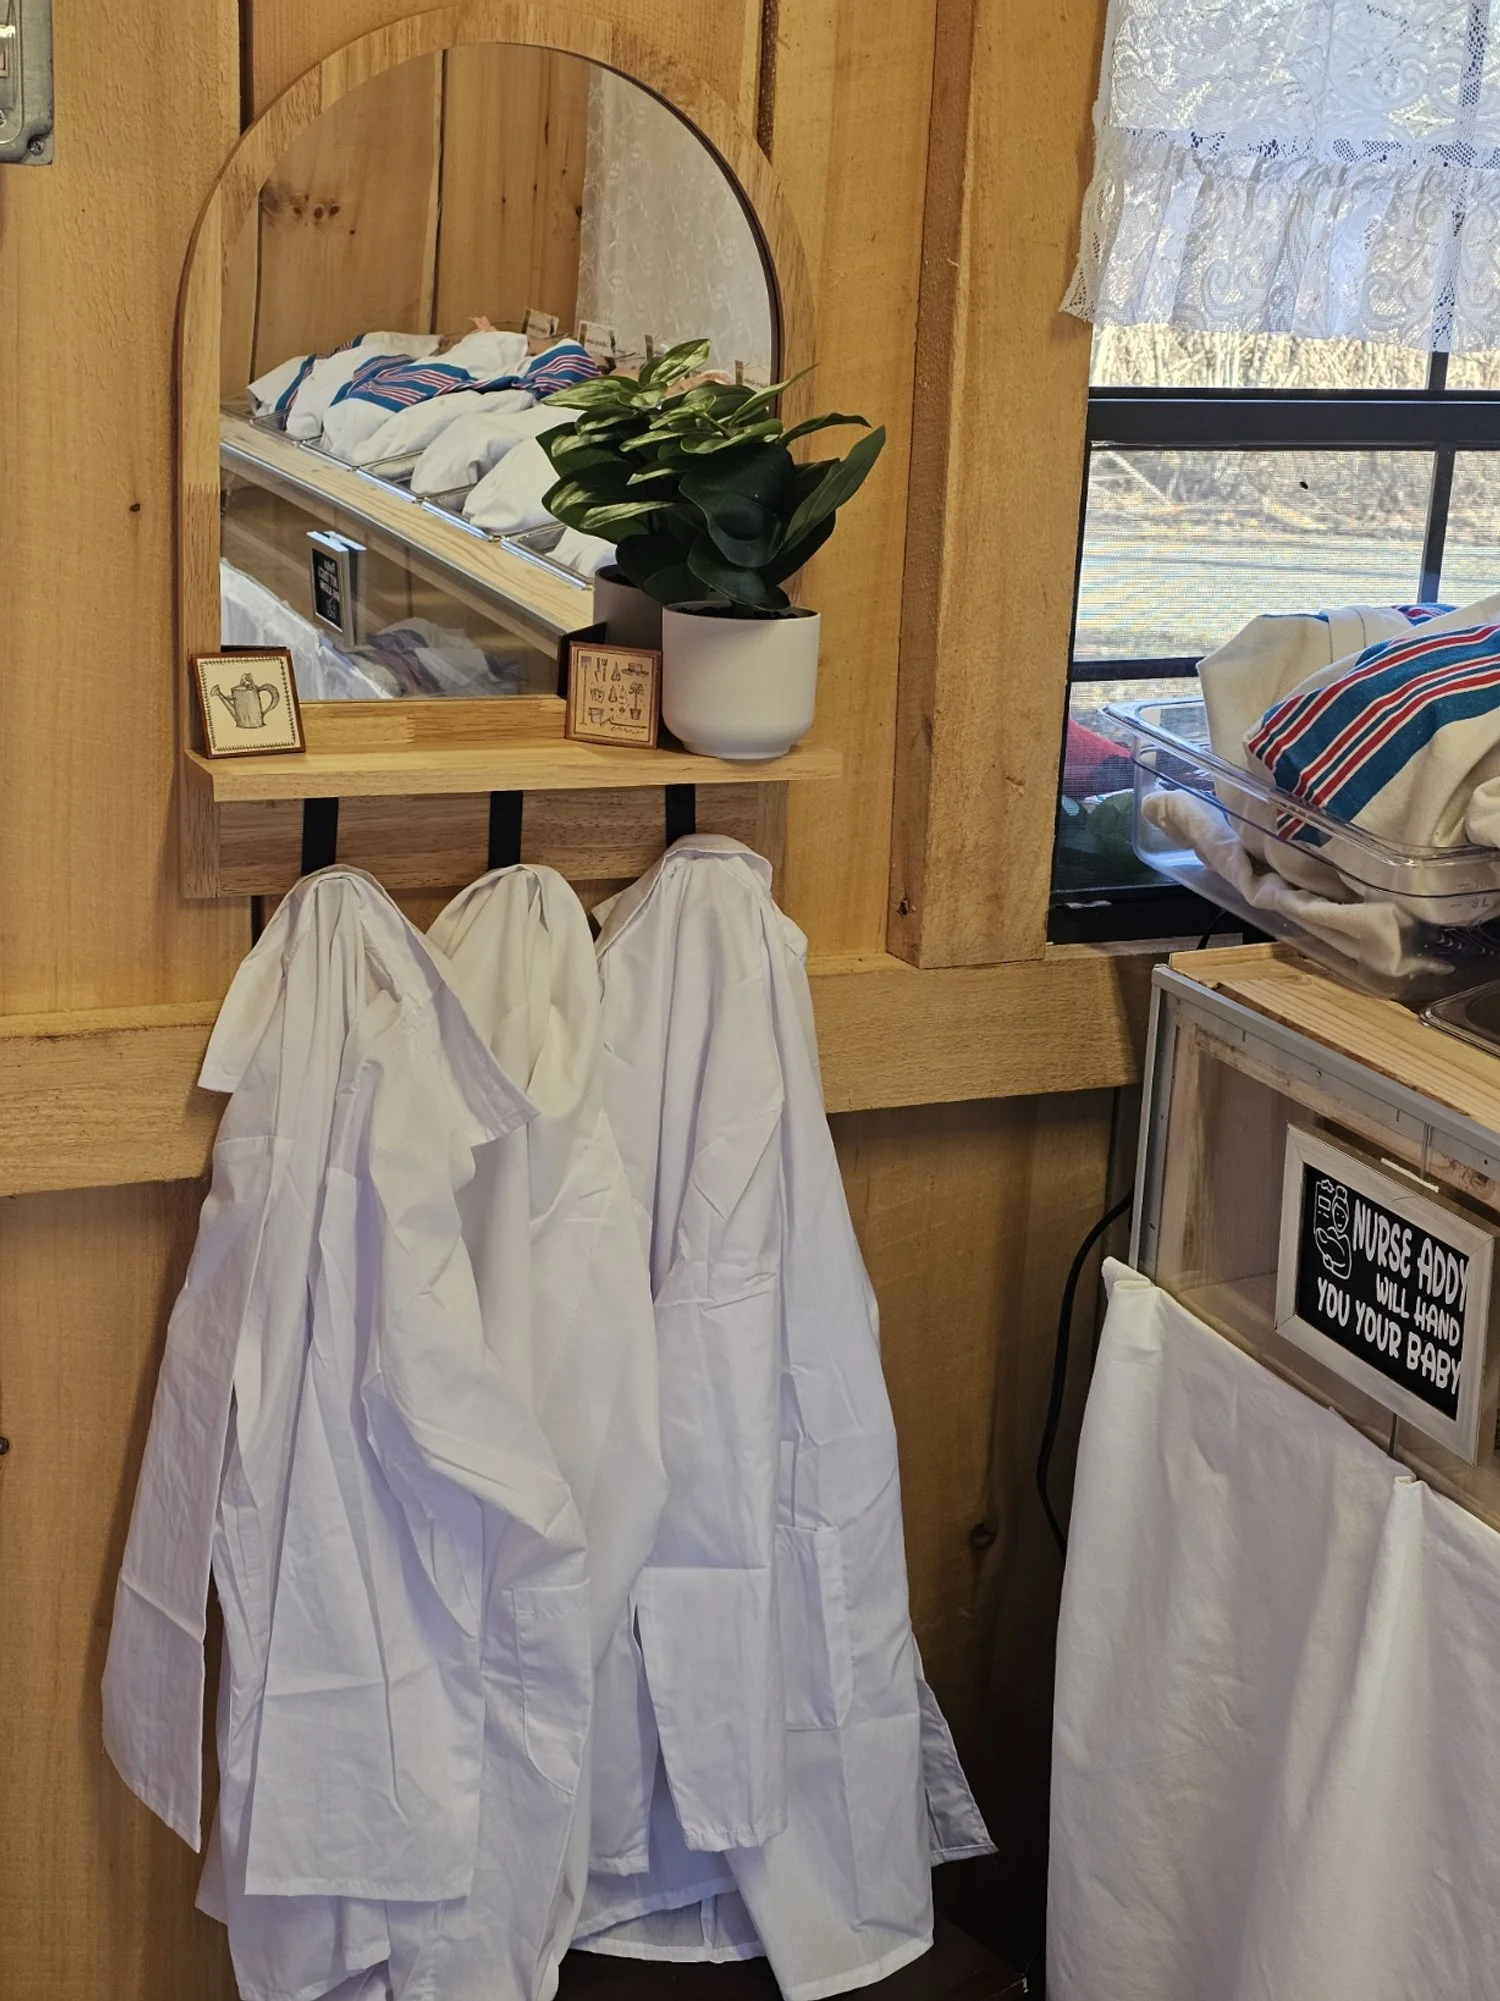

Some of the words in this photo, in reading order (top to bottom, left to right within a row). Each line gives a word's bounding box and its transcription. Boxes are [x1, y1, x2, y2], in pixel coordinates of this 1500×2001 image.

[1352, 1199, 1413, 1279] NURSE
[1417, 1237, 1469, 1312] ADDY
[1376, 1272, 1410, 1319] WILL
[1413, 1296, 1460, 1347] HAND
[1317, 1276, 1350, 1328] YOU
[1355, 1299, 1402, 1359] YOUR
[1406, 1331, 1461, 1395] BABY
